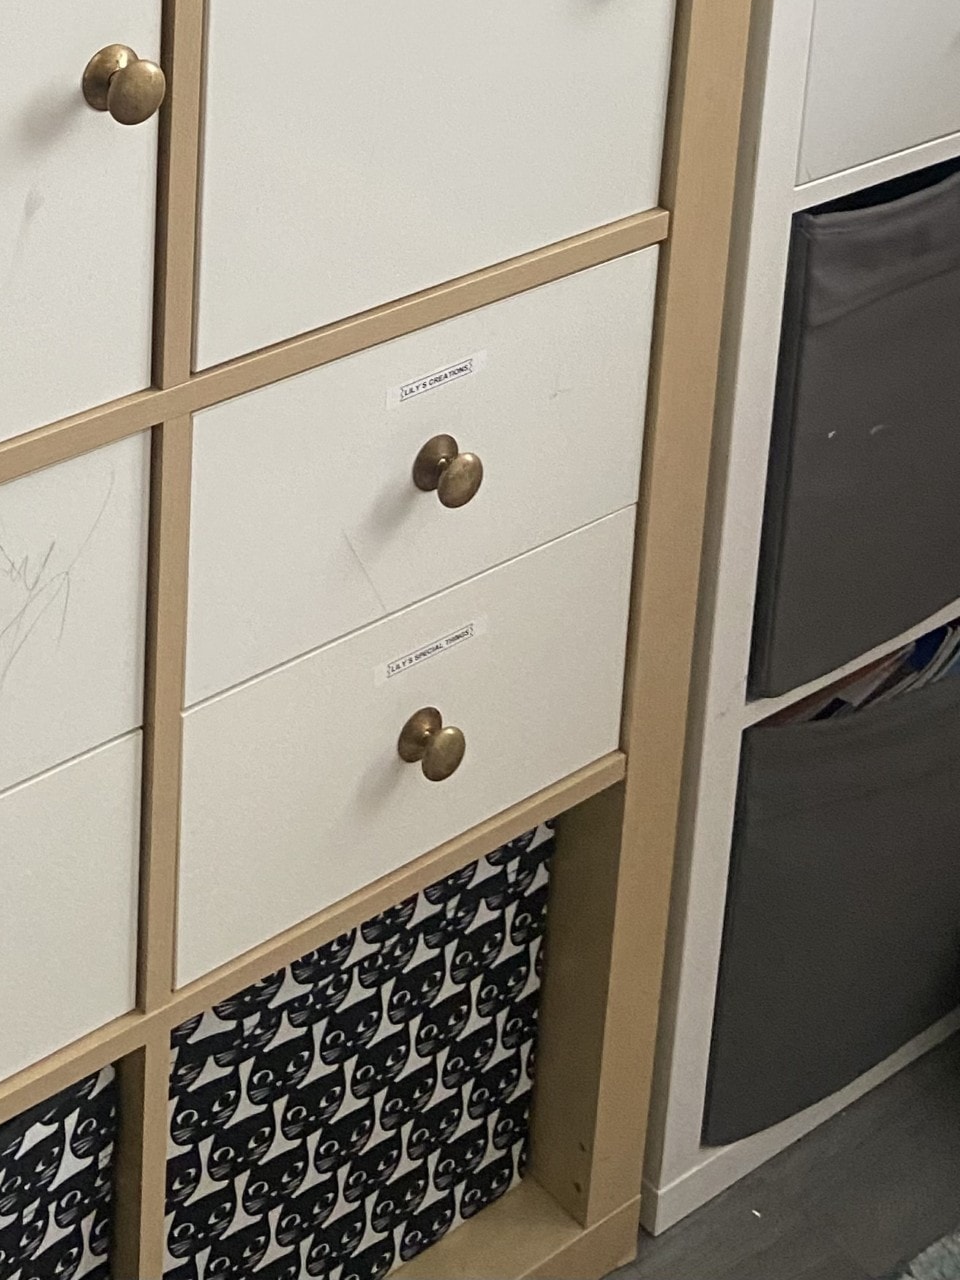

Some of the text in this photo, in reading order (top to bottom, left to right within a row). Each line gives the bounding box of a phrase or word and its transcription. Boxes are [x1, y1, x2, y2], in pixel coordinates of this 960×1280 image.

[403, 364, 470, 397] LILY'S CREATIONS
[414, 642, 444, 661] SPECIAL
[444, 629, 470, 646] THINGS
